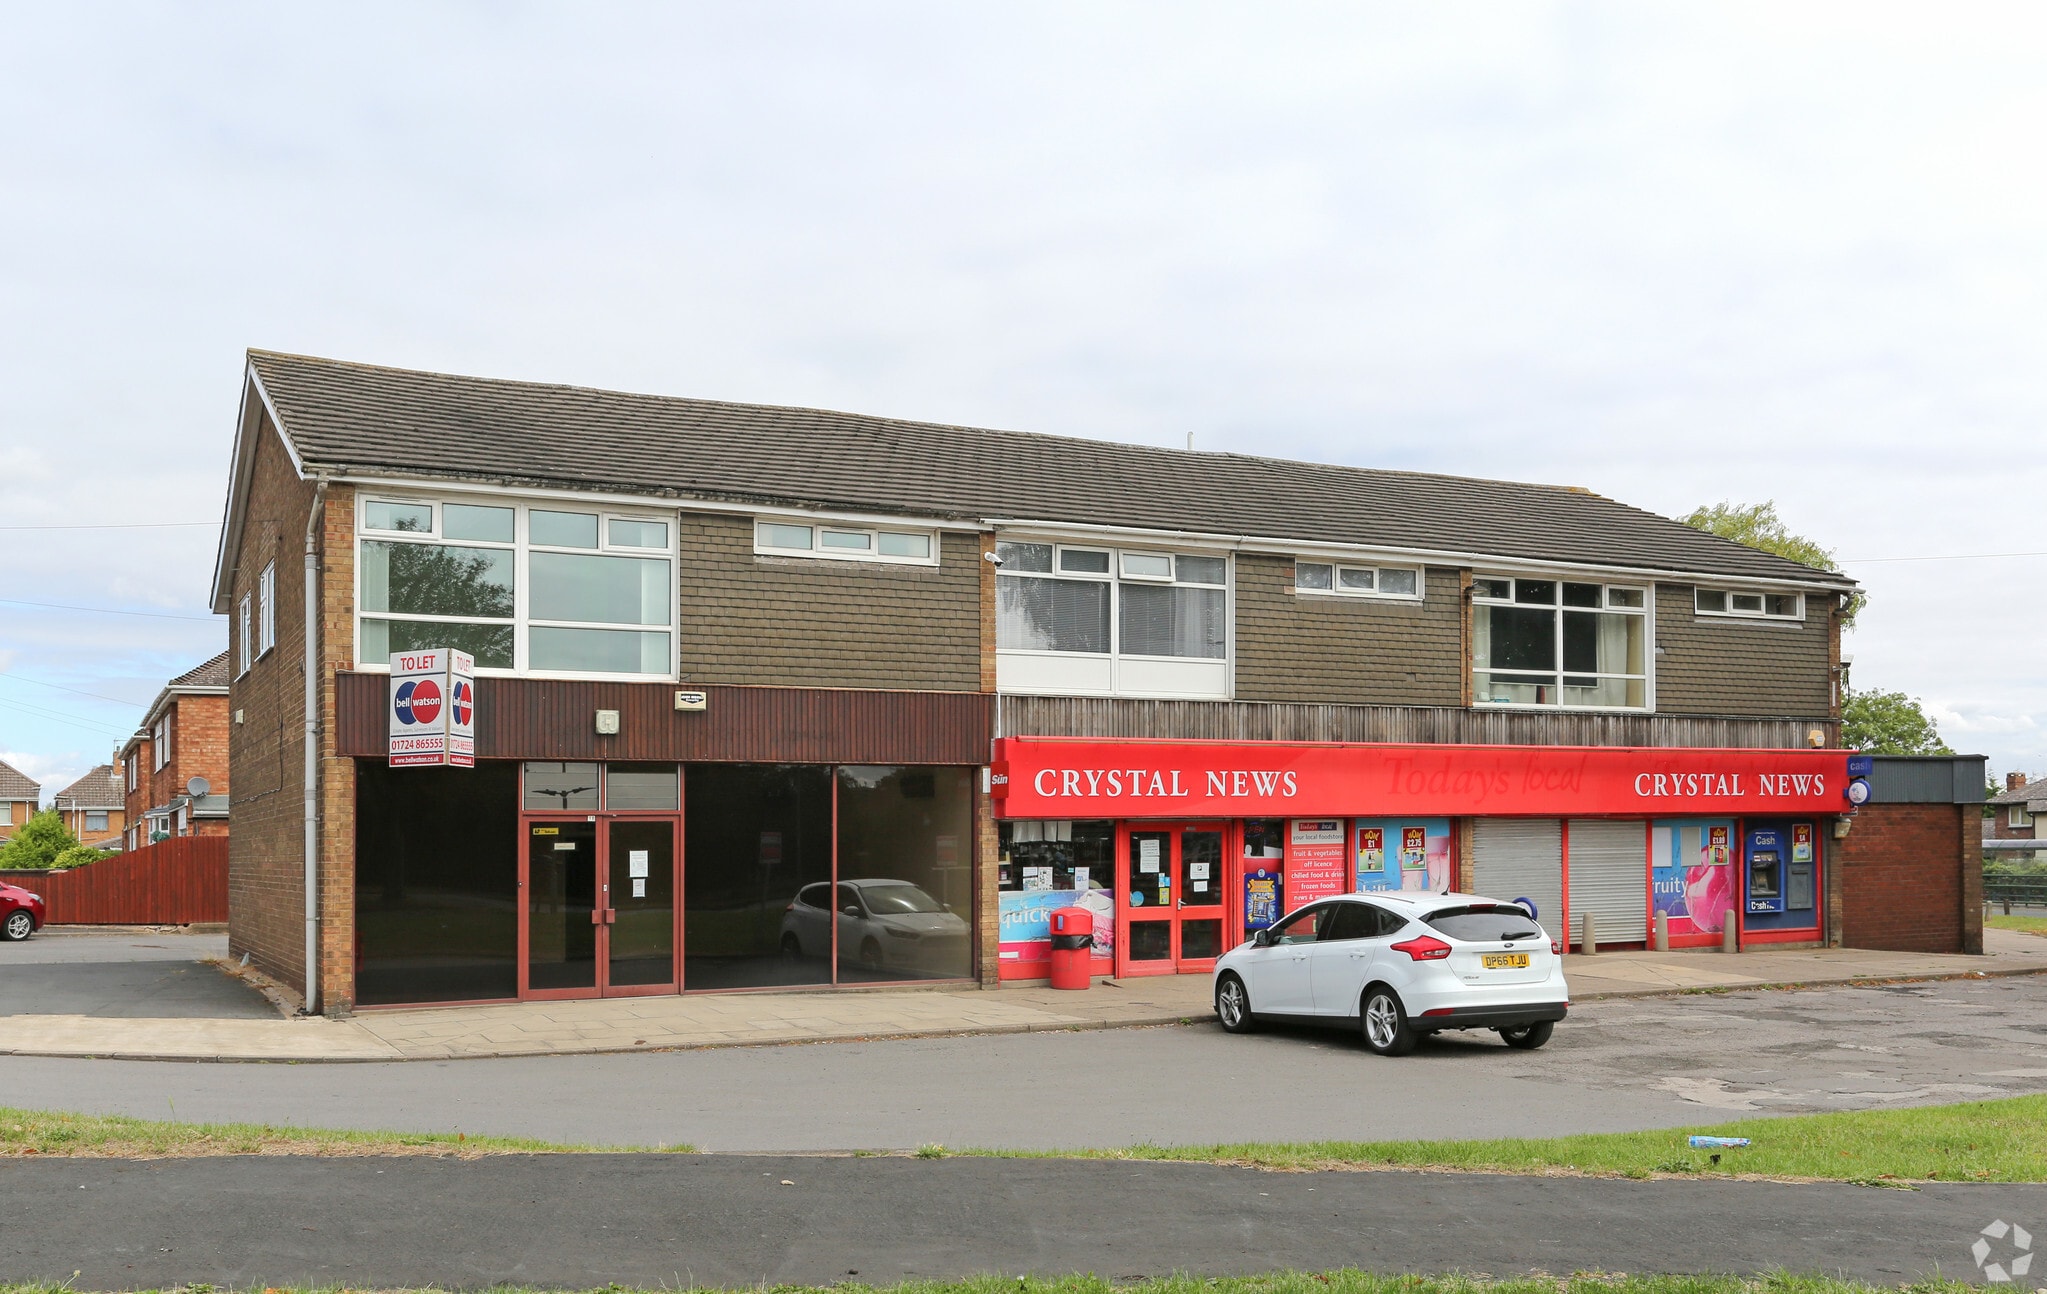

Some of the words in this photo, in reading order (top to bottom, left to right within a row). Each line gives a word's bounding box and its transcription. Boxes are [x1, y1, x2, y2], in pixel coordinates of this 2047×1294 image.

[400, 657, 415, 670] TO
[417, 655, 436, 670] LET
[396, 698, 410, 707] bell
[412, 697, 440, 707] watson
[392, 740, 414, 750] 01724
[416, 738, 443, 748] 865555
[991, 774, 1008, 785] Sun
[1034, 769, 1188, 797] CRYSTAL
[1206, 770, 1298, 797] NEWS
[1634, 772, 1745, 797] CRYSTAL
[1759, 773, 1826, 796] NEWS
[1756, 836, 1775, 845] Cash
[1486, 956, 1508, 966] DP66
[1511, 956, 1527, 965] TJU
